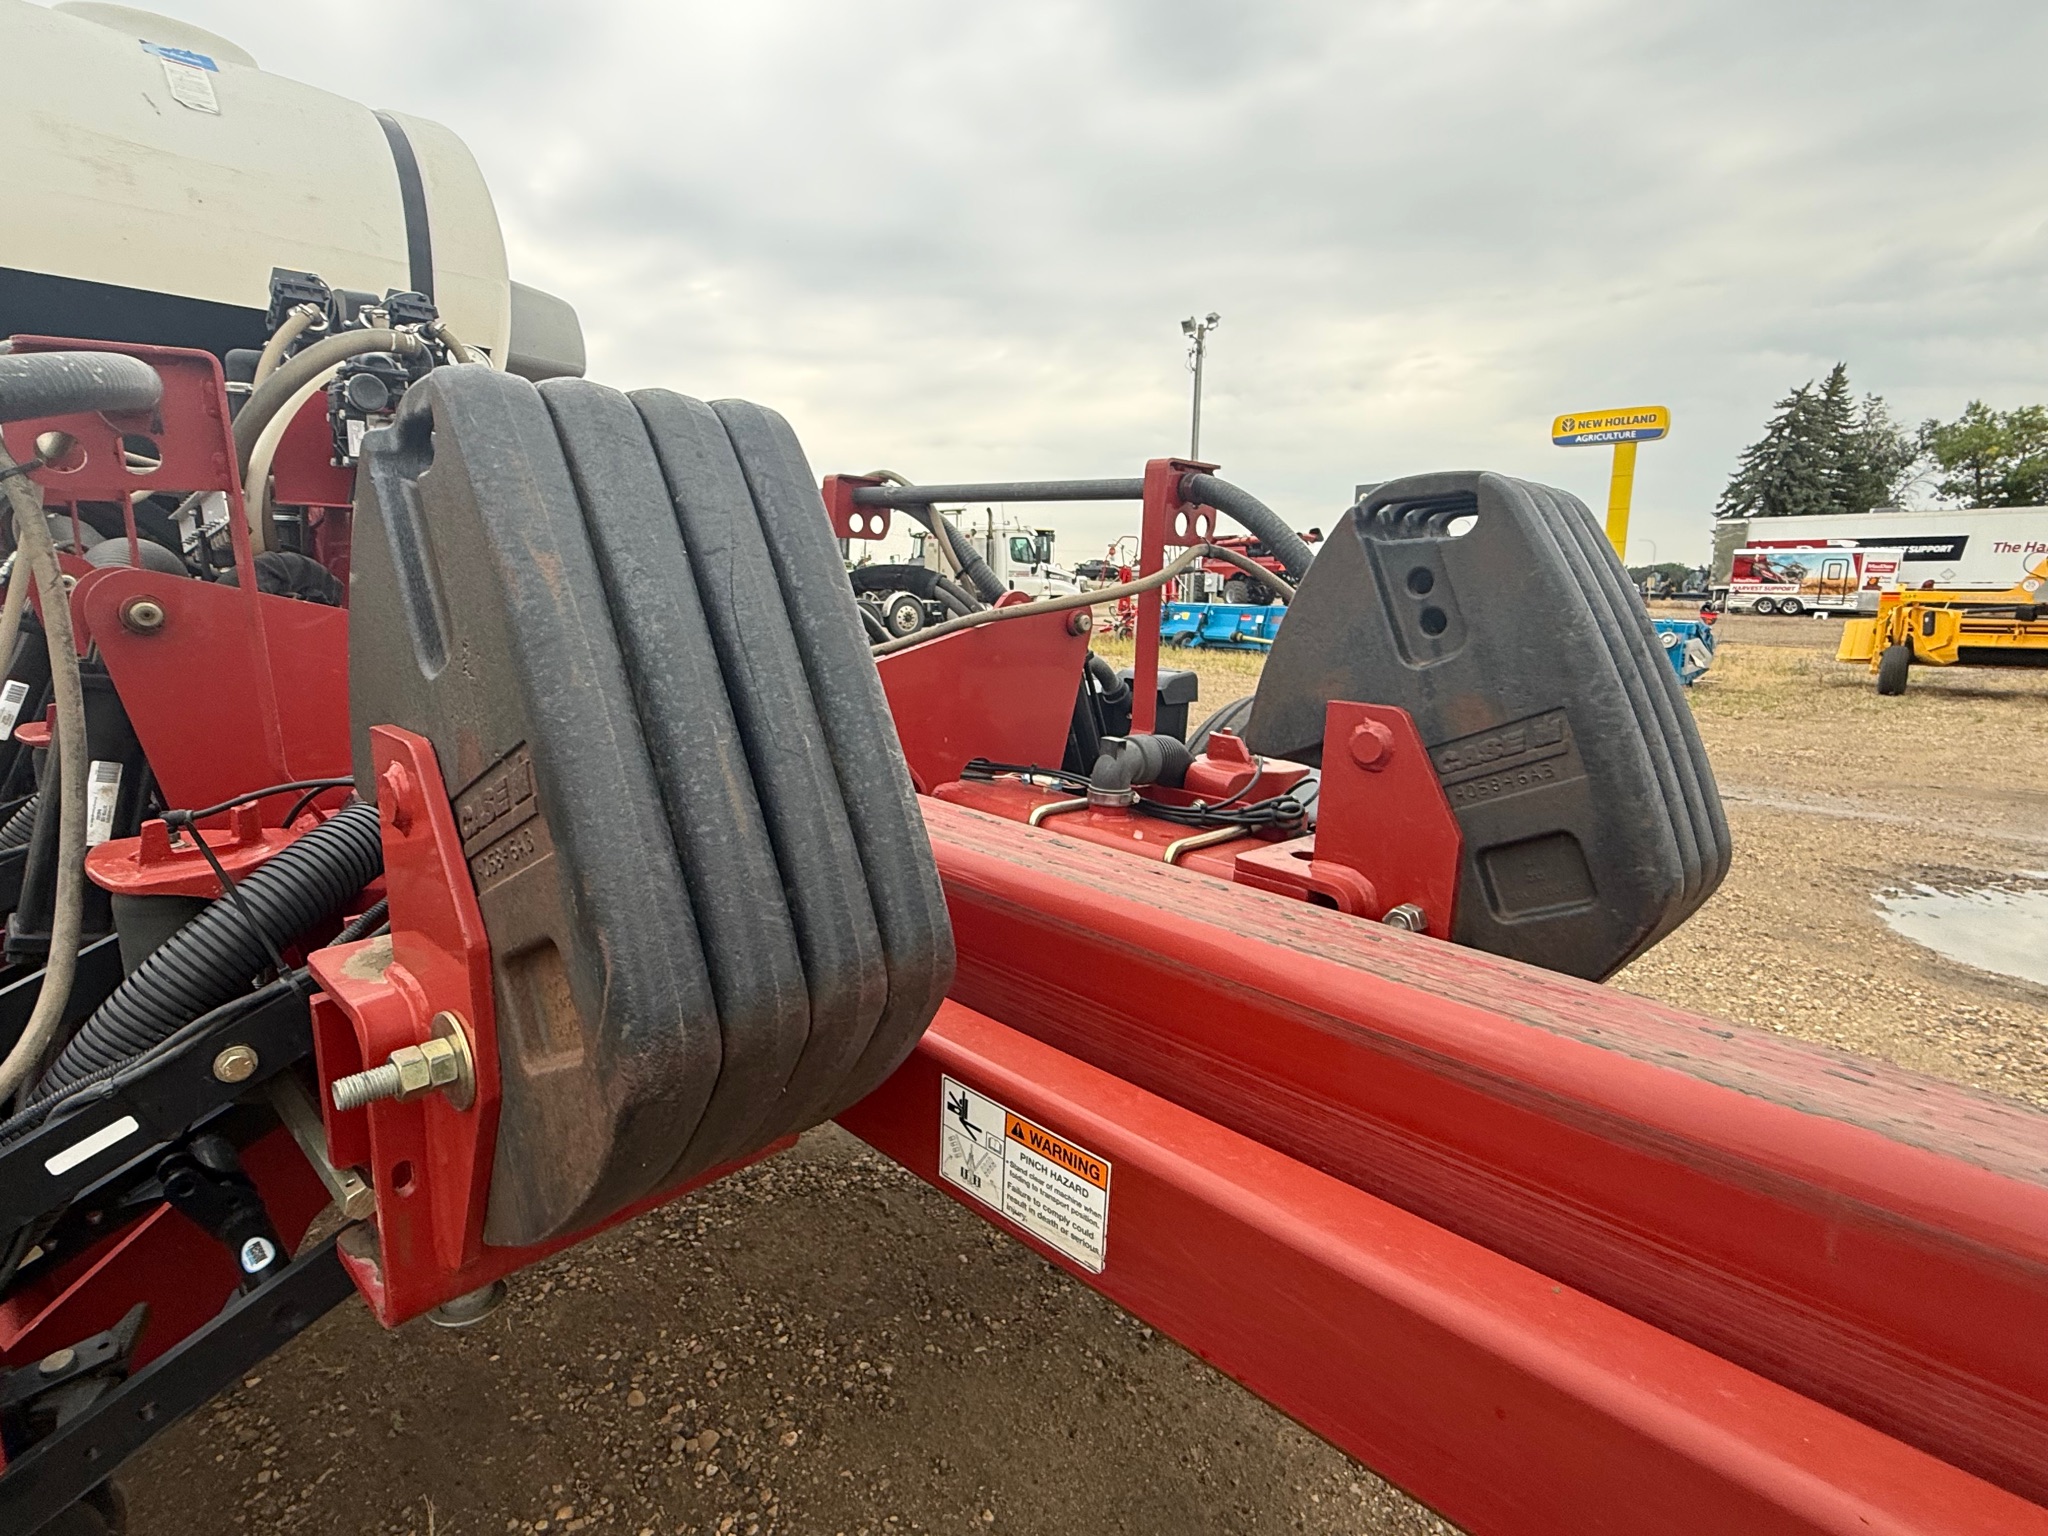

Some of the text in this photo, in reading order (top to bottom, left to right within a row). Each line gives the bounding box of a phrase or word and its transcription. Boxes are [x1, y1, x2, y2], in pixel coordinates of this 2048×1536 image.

[1575, 431, 1637, 442] AGRICULTURE
[1578, 414, 1657, 429] NEW HOLLAND
[1908, 545, 1954, 553] SUPPORT
[1994, 542, 2021, 553] The
[1020, 1152, 1090, 1199] PINCH HAZARD
[1029, 1129, 1100, 1181] WARNING
[1007, 1181, 1095, 1240] Failure to comply could
[1009, 1160, 1102, 1220] Stand clear of machine when
[1009, 1169, 1031, 1189] folding
[1032, 1183, 1039, 1192] to
[1040, 1187, 1070, 1211] transport
[1007, 1193, 1100, 1255] result in death or serious
